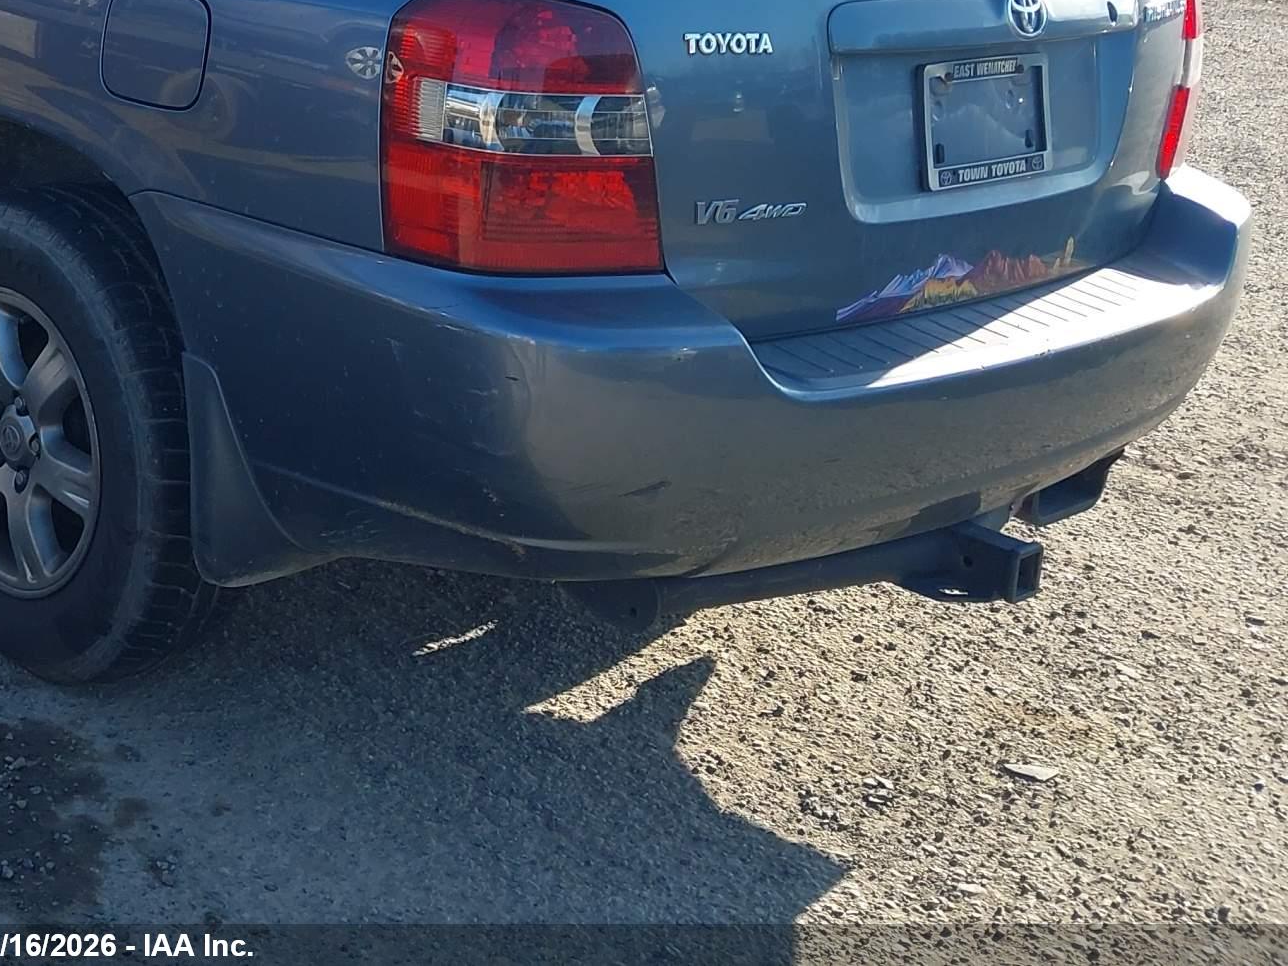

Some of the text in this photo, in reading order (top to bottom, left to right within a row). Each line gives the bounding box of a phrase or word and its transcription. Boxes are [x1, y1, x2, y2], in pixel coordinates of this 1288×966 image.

[684, 32, 774, 54] TOYOTA
[953, 63, 975, 79] EAST
[957, 159, 1027, 183] TOWN TOYOTA
[696, 199, 807, 225] V6 4WD
